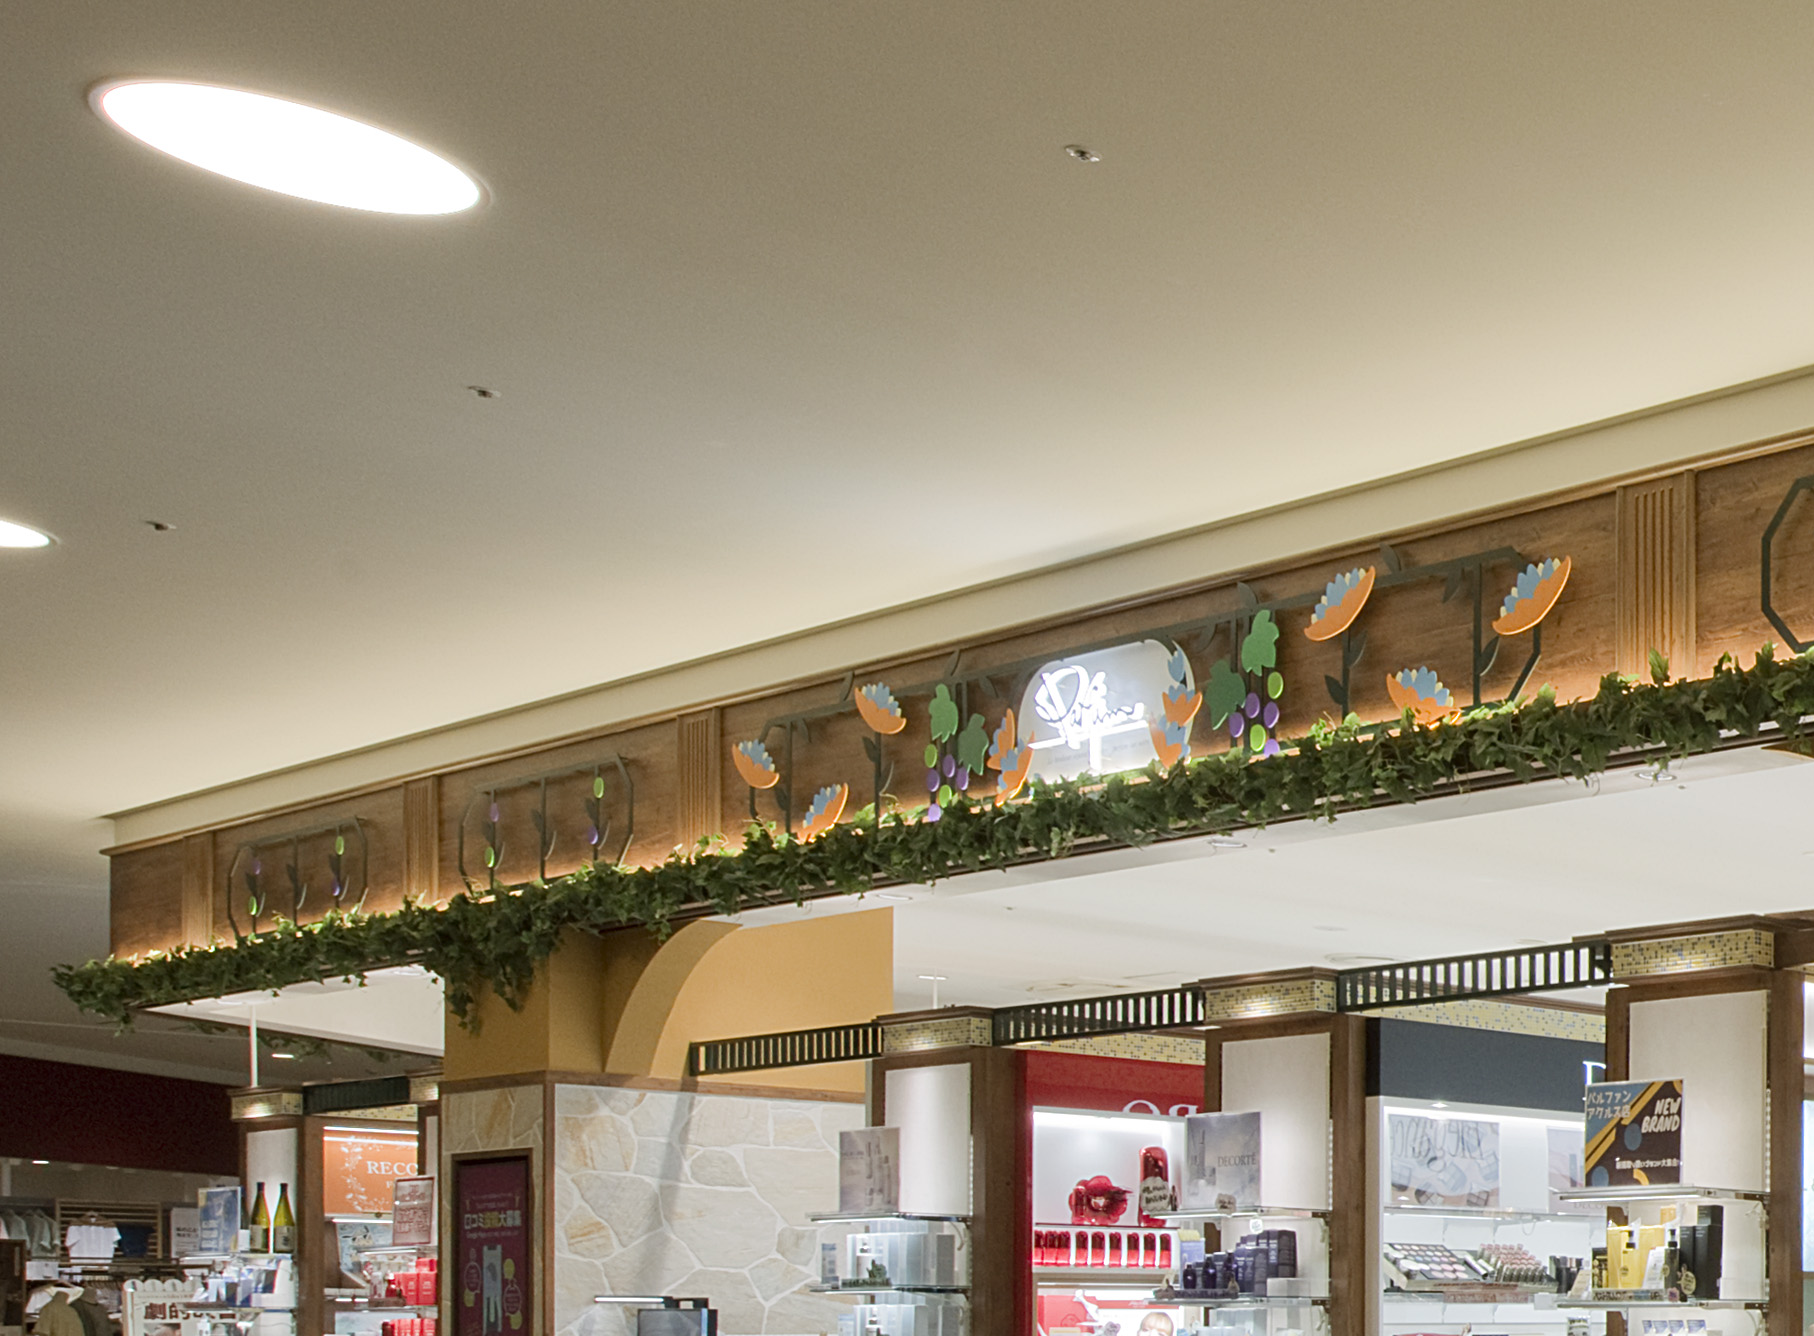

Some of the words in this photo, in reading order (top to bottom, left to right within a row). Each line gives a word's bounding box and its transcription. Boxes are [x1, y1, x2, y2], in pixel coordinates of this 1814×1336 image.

[1587, 1090, 1632, 1105] パルファン
[1587, 1105, 1632, 1120] アクルス店
[1654, 1097, 1682, 1115] NEW
[1641, 1116, 1681, 1134] BRAND
